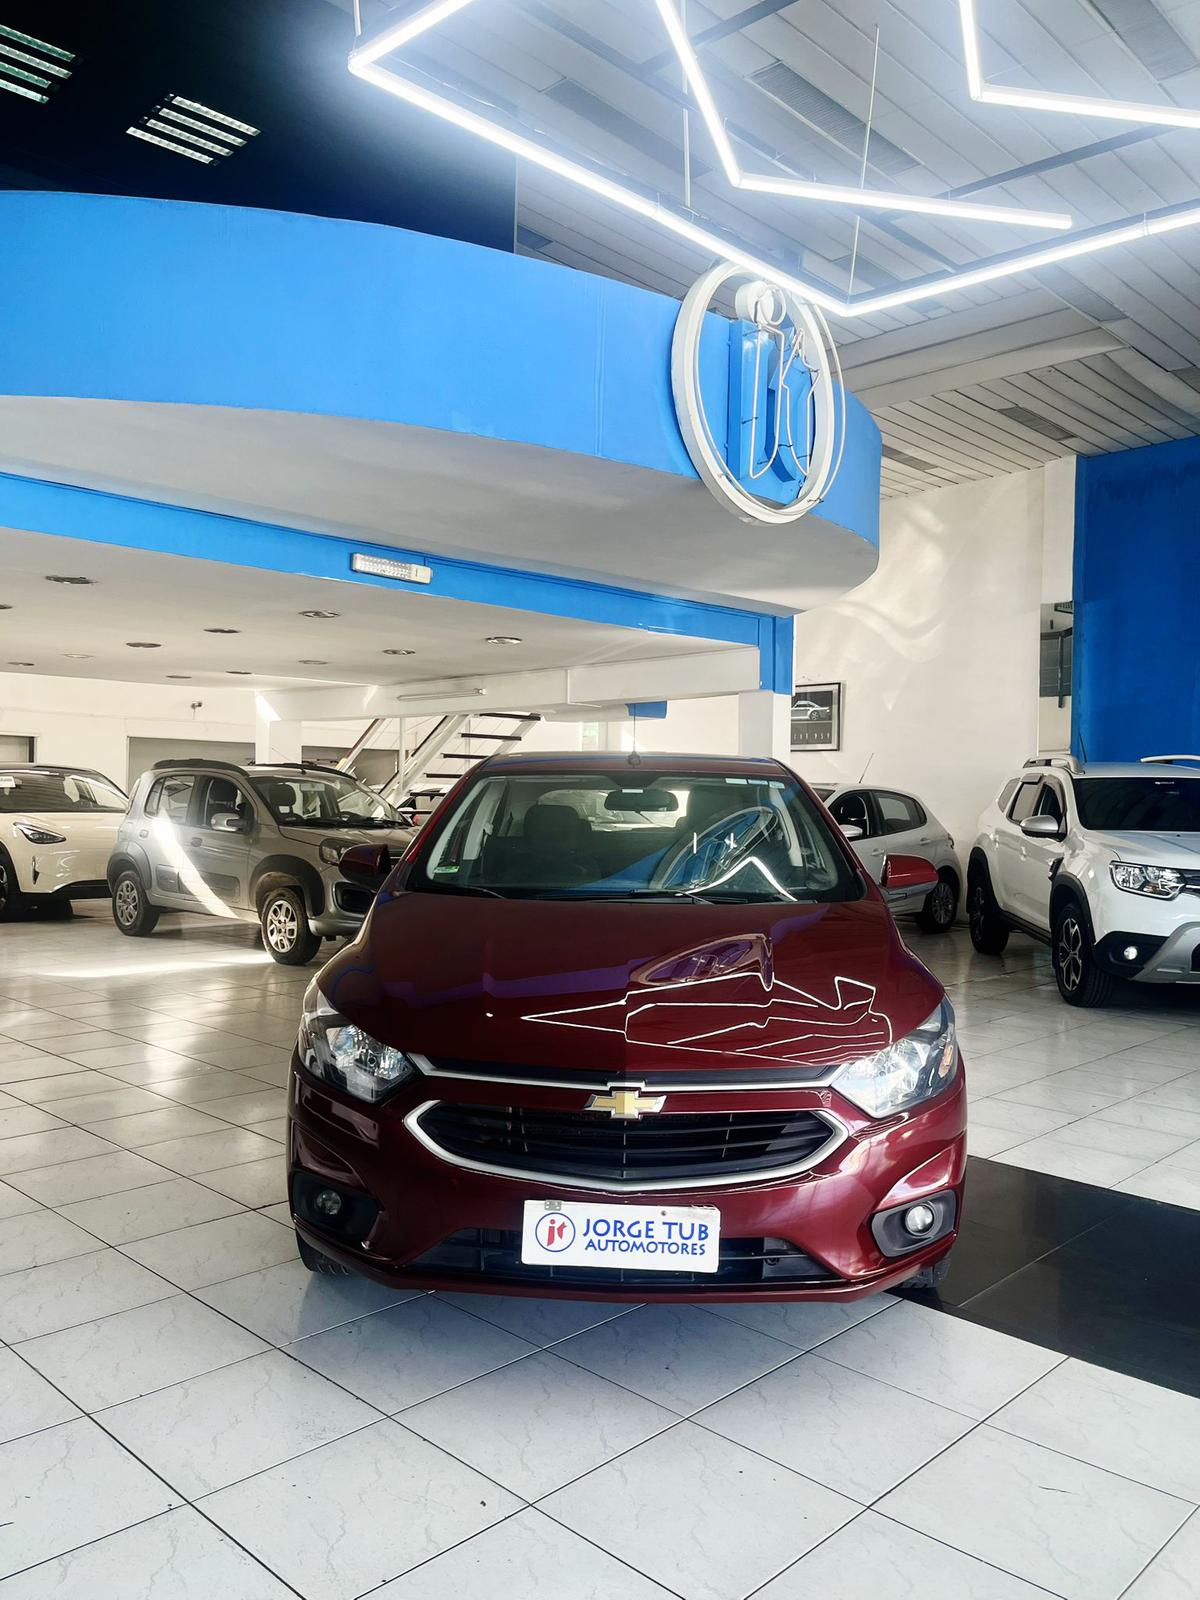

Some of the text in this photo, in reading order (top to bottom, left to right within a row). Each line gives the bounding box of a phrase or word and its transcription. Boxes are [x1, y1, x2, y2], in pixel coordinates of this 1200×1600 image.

[583, 1218, 709, 1241] JORGE TUB
[585, 1238, 706, 1256] AUTOMOTORES
